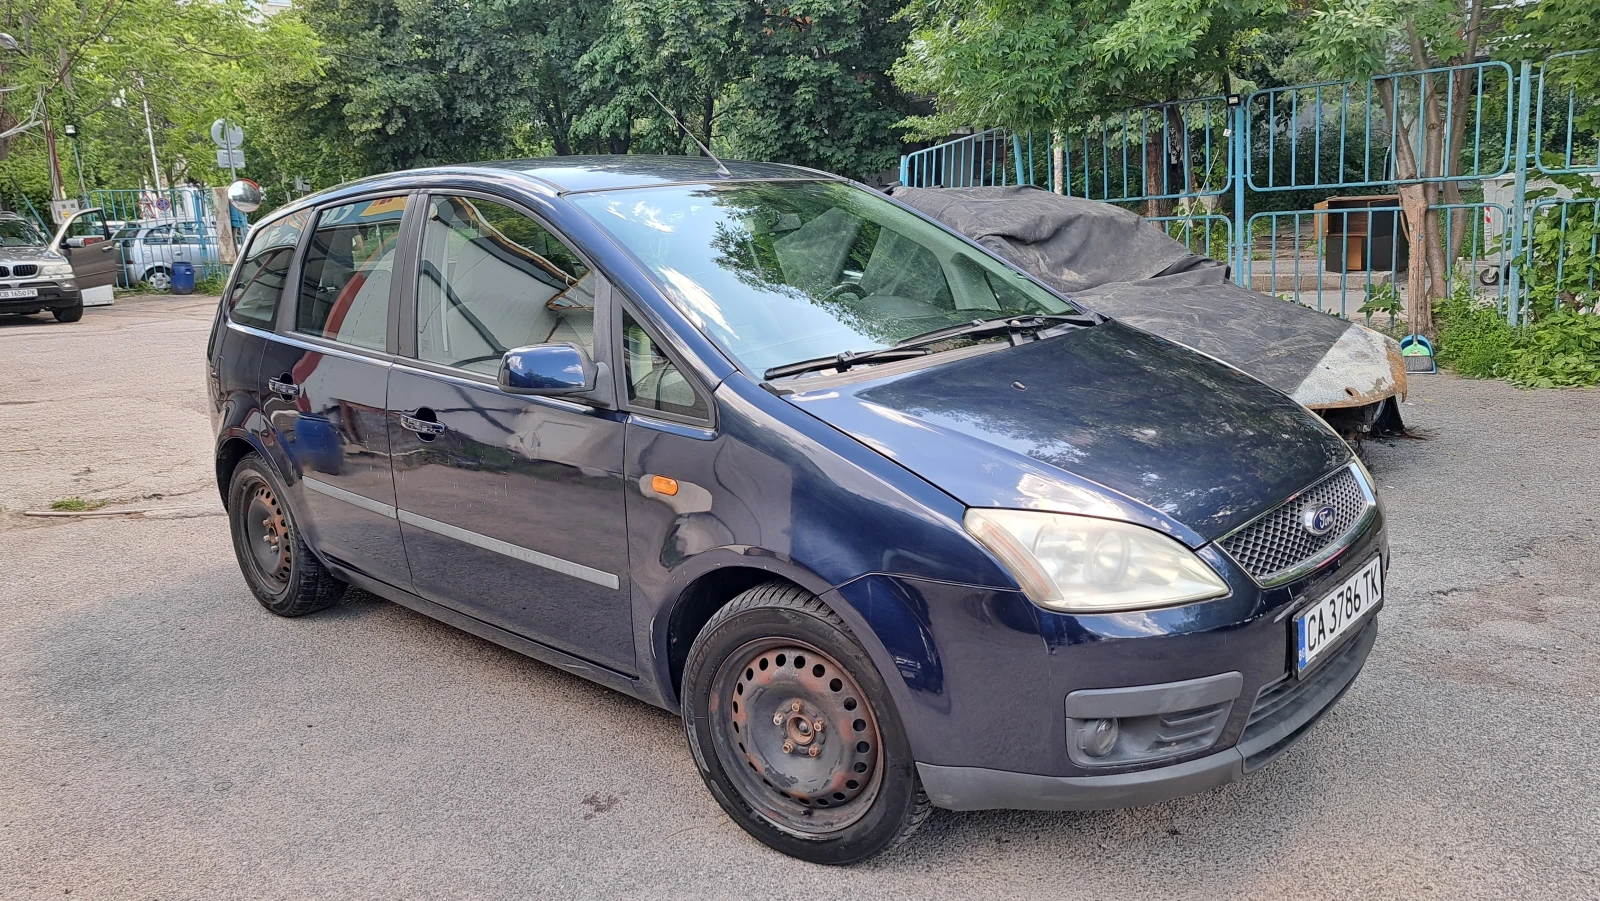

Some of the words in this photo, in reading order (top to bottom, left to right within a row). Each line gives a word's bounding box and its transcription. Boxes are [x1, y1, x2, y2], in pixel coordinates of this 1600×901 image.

[1319, 510, 1334, 529] Ford
[1308, 607, 1327, 652] CA
[1329, 578, 1361, 634] 3786
[1363, 563, 1379, 604] TK
[1299, 647, 1306, 661] BG
